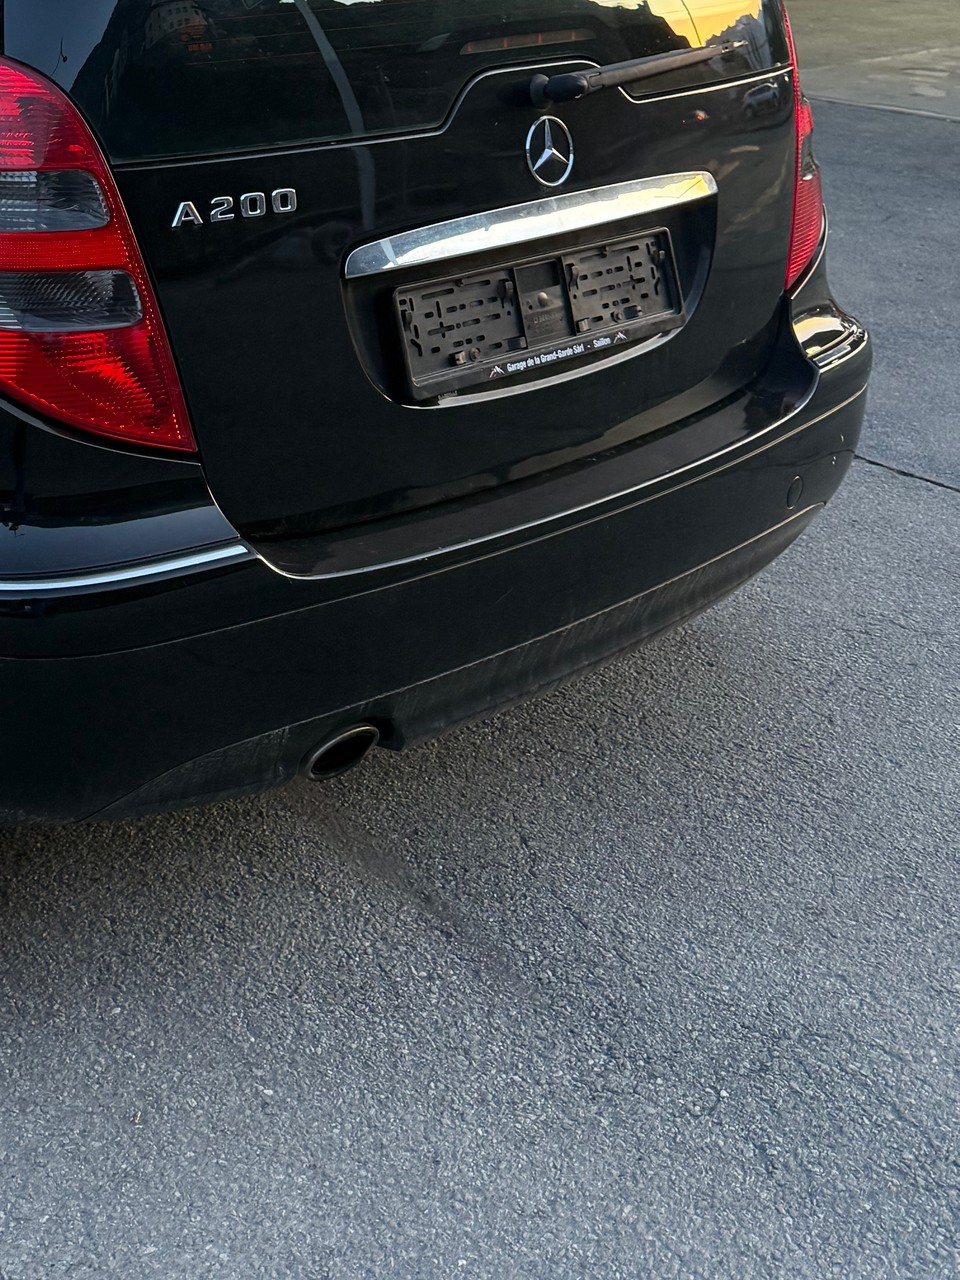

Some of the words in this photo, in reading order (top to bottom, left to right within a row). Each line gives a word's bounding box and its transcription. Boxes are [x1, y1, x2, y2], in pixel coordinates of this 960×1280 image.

[507, 359, 527, 371] Garage
[527, 357, 535, 367] de
[534, 355, 541, 364] la
[540, 347, 573, 363] Grand-Garde
